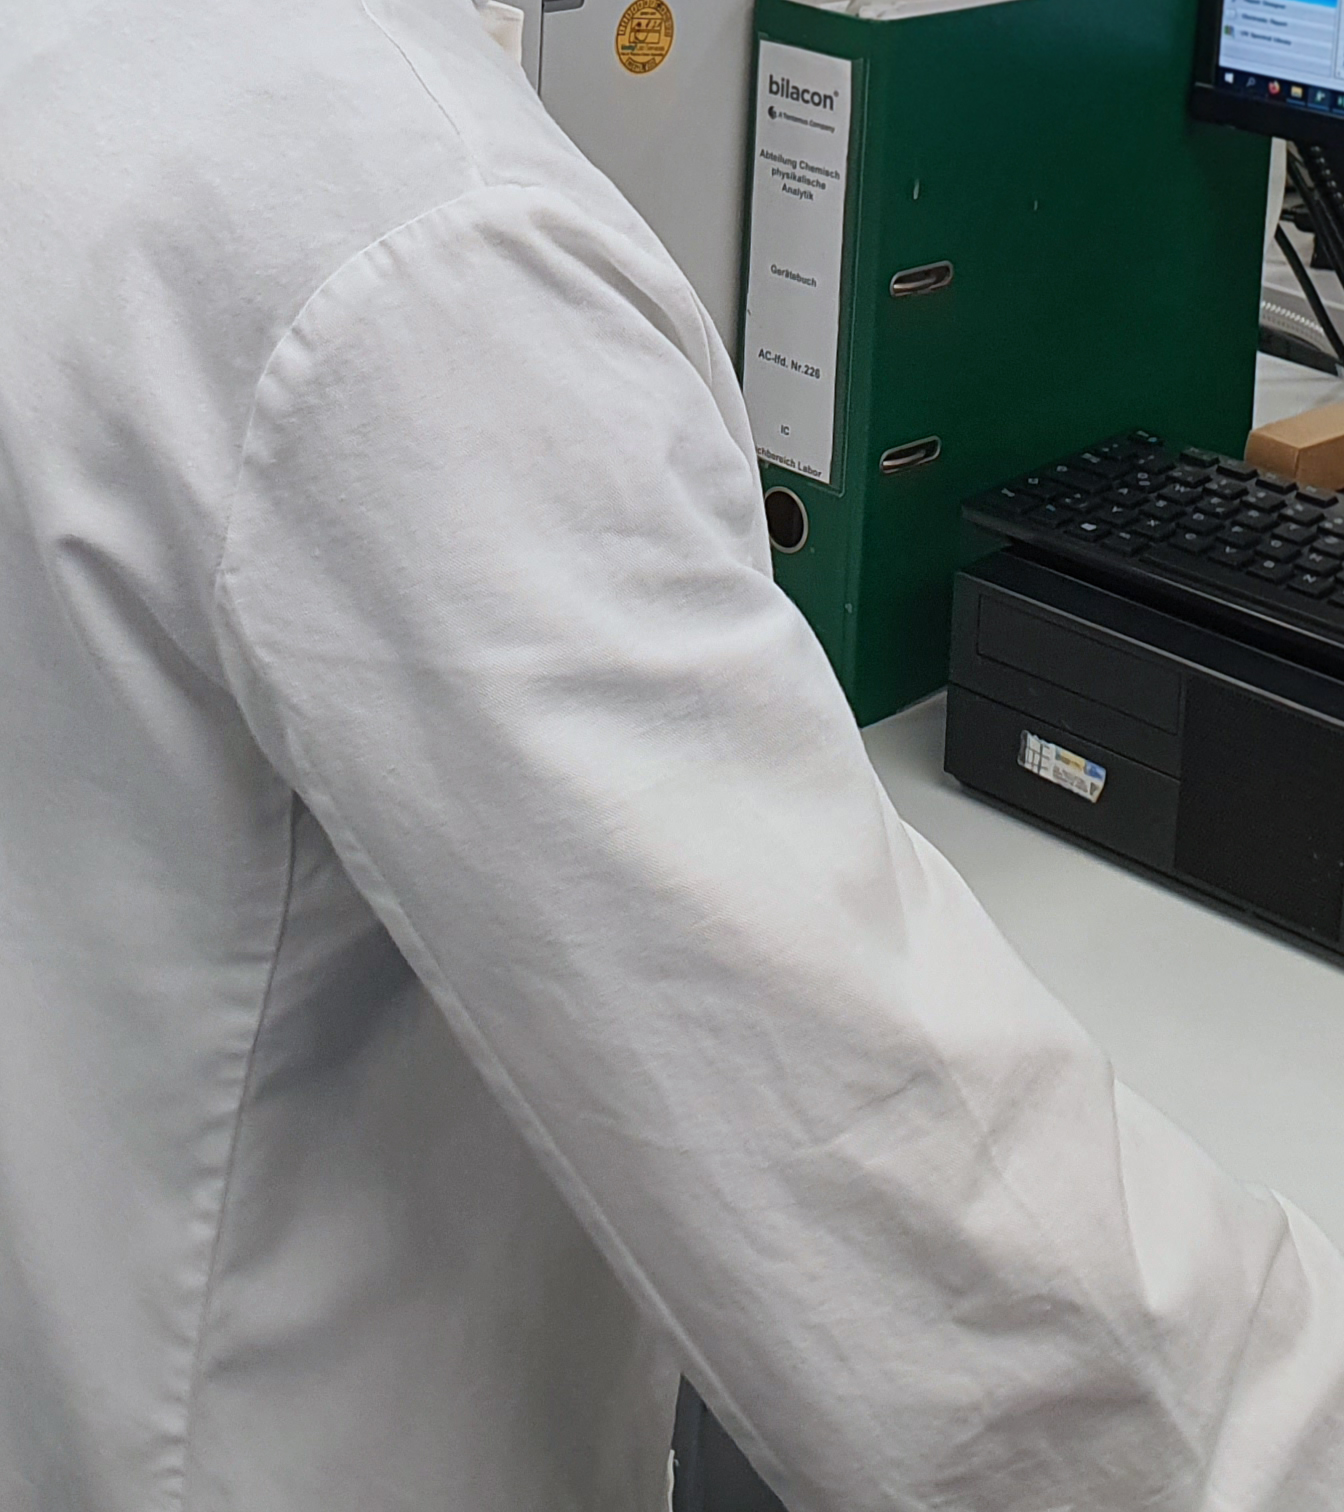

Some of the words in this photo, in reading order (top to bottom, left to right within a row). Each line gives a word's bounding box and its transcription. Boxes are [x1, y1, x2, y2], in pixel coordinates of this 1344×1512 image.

[759, 148, 798, 170] Abteilung
[799, 159, 841, 180] Chemisch
[771, 166, 827, 190] physikalische
[781, 182, 814, 201] Analytik
[770, 263, 817, 288] Gerätebuch
[780, 423, 790, 436] IC
[756, 445, 796, 469] chbereich
[797, 460, 823, 478] Labor
